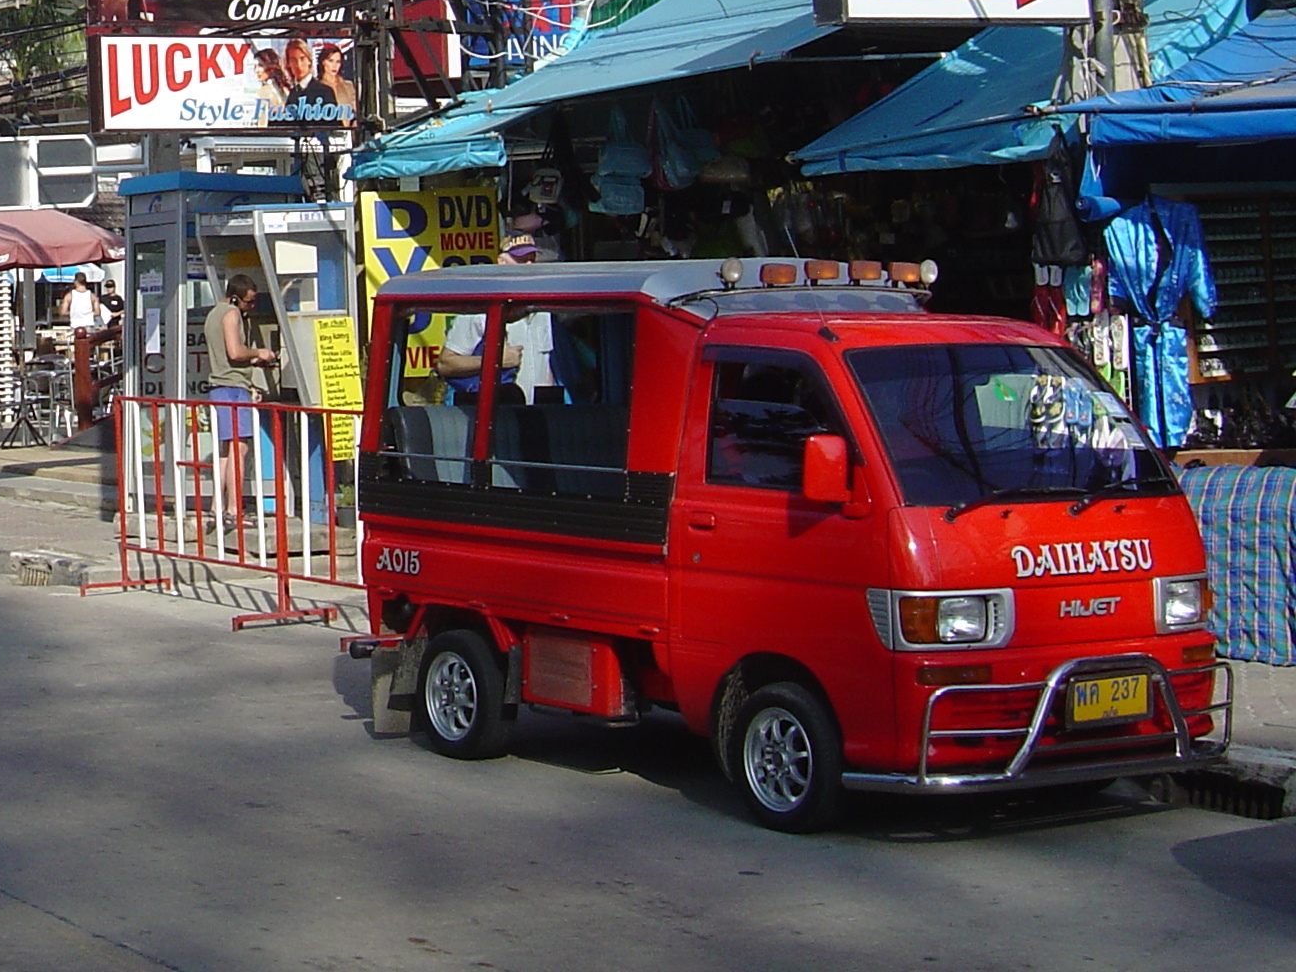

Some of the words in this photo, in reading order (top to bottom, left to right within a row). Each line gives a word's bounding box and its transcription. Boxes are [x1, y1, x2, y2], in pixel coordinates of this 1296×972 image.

[107, 42, 253, 119] LUCKY
[179, 96, 244, 126] Style
[253, 96, 354, 122] Fashion
[437, 195, 493, 229] DVD
[440, 232, 495, 251] MOVIE
[407, 345, 441, 369] VIE
[376, 547, 420, 575] A015
[1011, 538, 1154, 580] DAIHATSU
[1059, 596, 1122, 619] HIJET
[1111, 677, 1141, 702] 237
